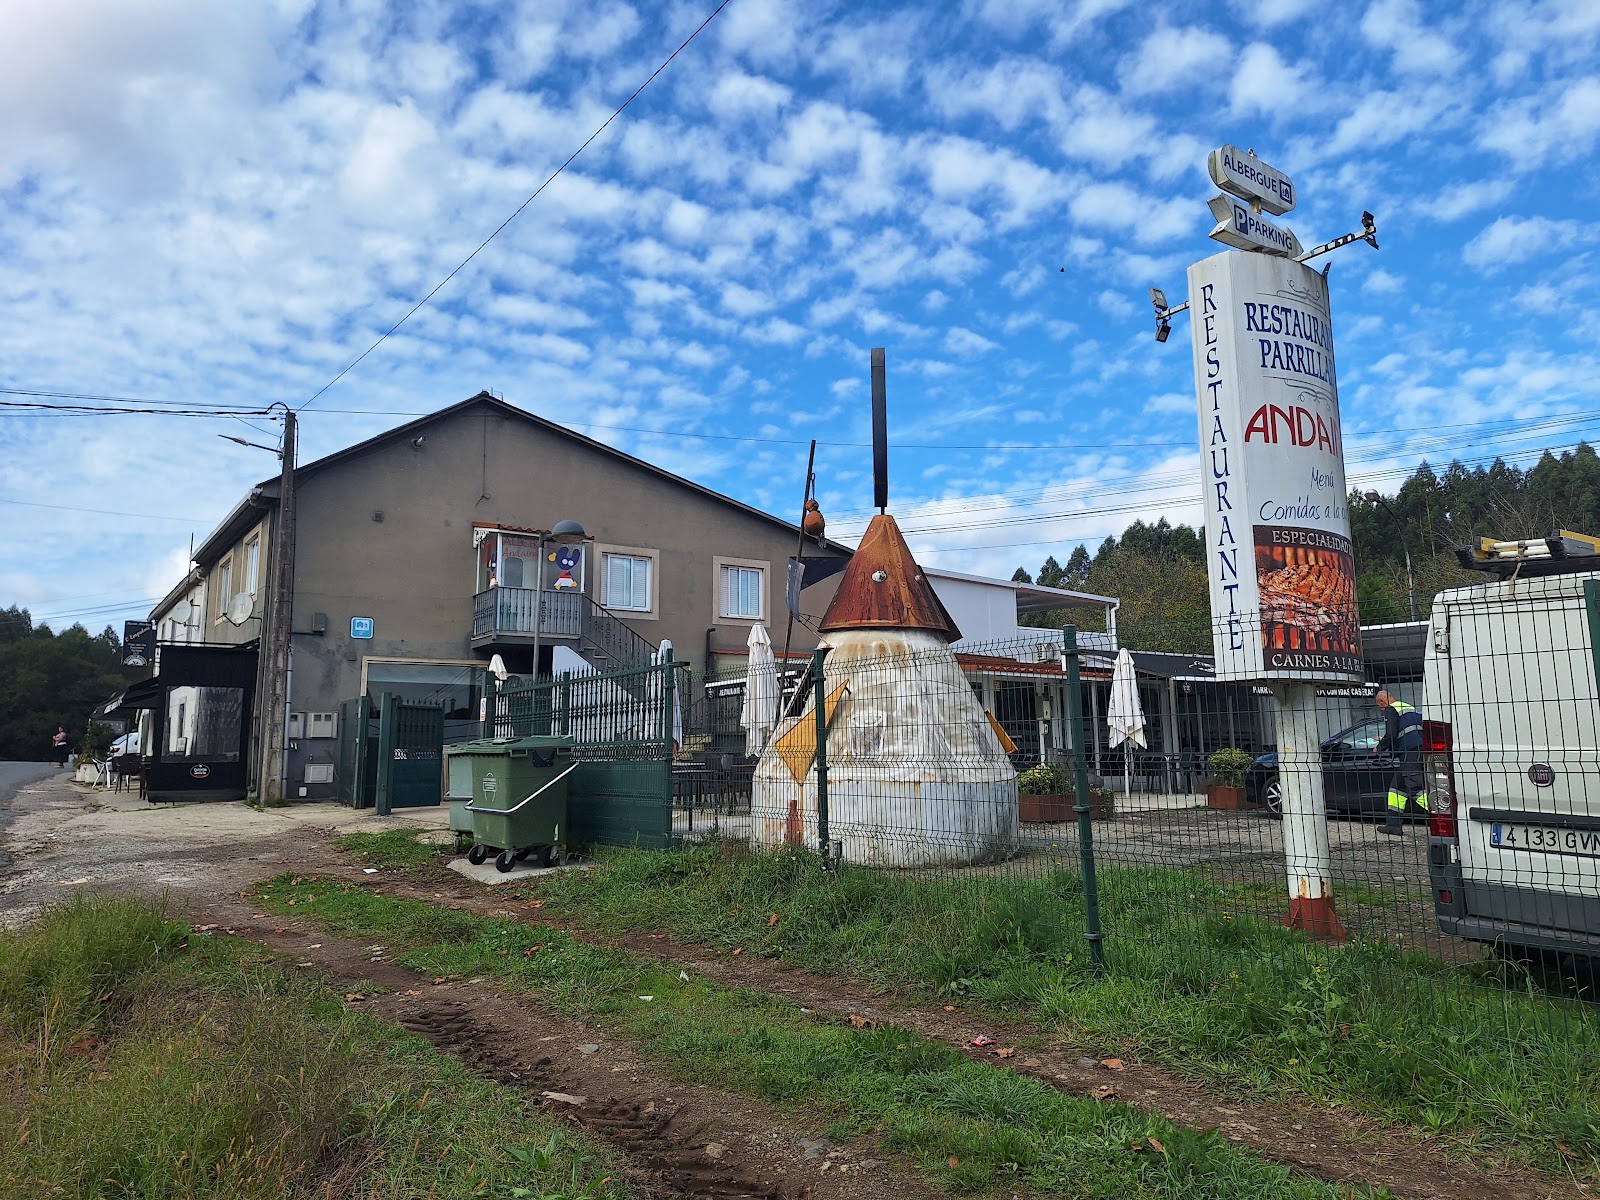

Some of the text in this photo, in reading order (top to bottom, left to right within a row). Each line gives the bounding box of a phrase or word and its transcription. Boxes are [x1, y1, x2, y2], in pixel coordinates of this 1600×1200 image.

[1223, 154, 1278, 193] ALBERGUE
[1248, 218, 1293, 250] PARKING
[1244, 302, 1333, 354] RESTAURAN
[1200, 283, 1243, 651] RESTAURANTE
[1310, 467, 1335, 491] Menú
[1259, 494, 1321, 521] Comidas
[1324, 505, 1331, 519] a
[1272, 530, 1349, 554] ESPECIALIDAD
[1271, 654, 1331, 669] CARNES
[1332, 656, 1341, 670] A
[1506, 827, 1557, 847] 4133
